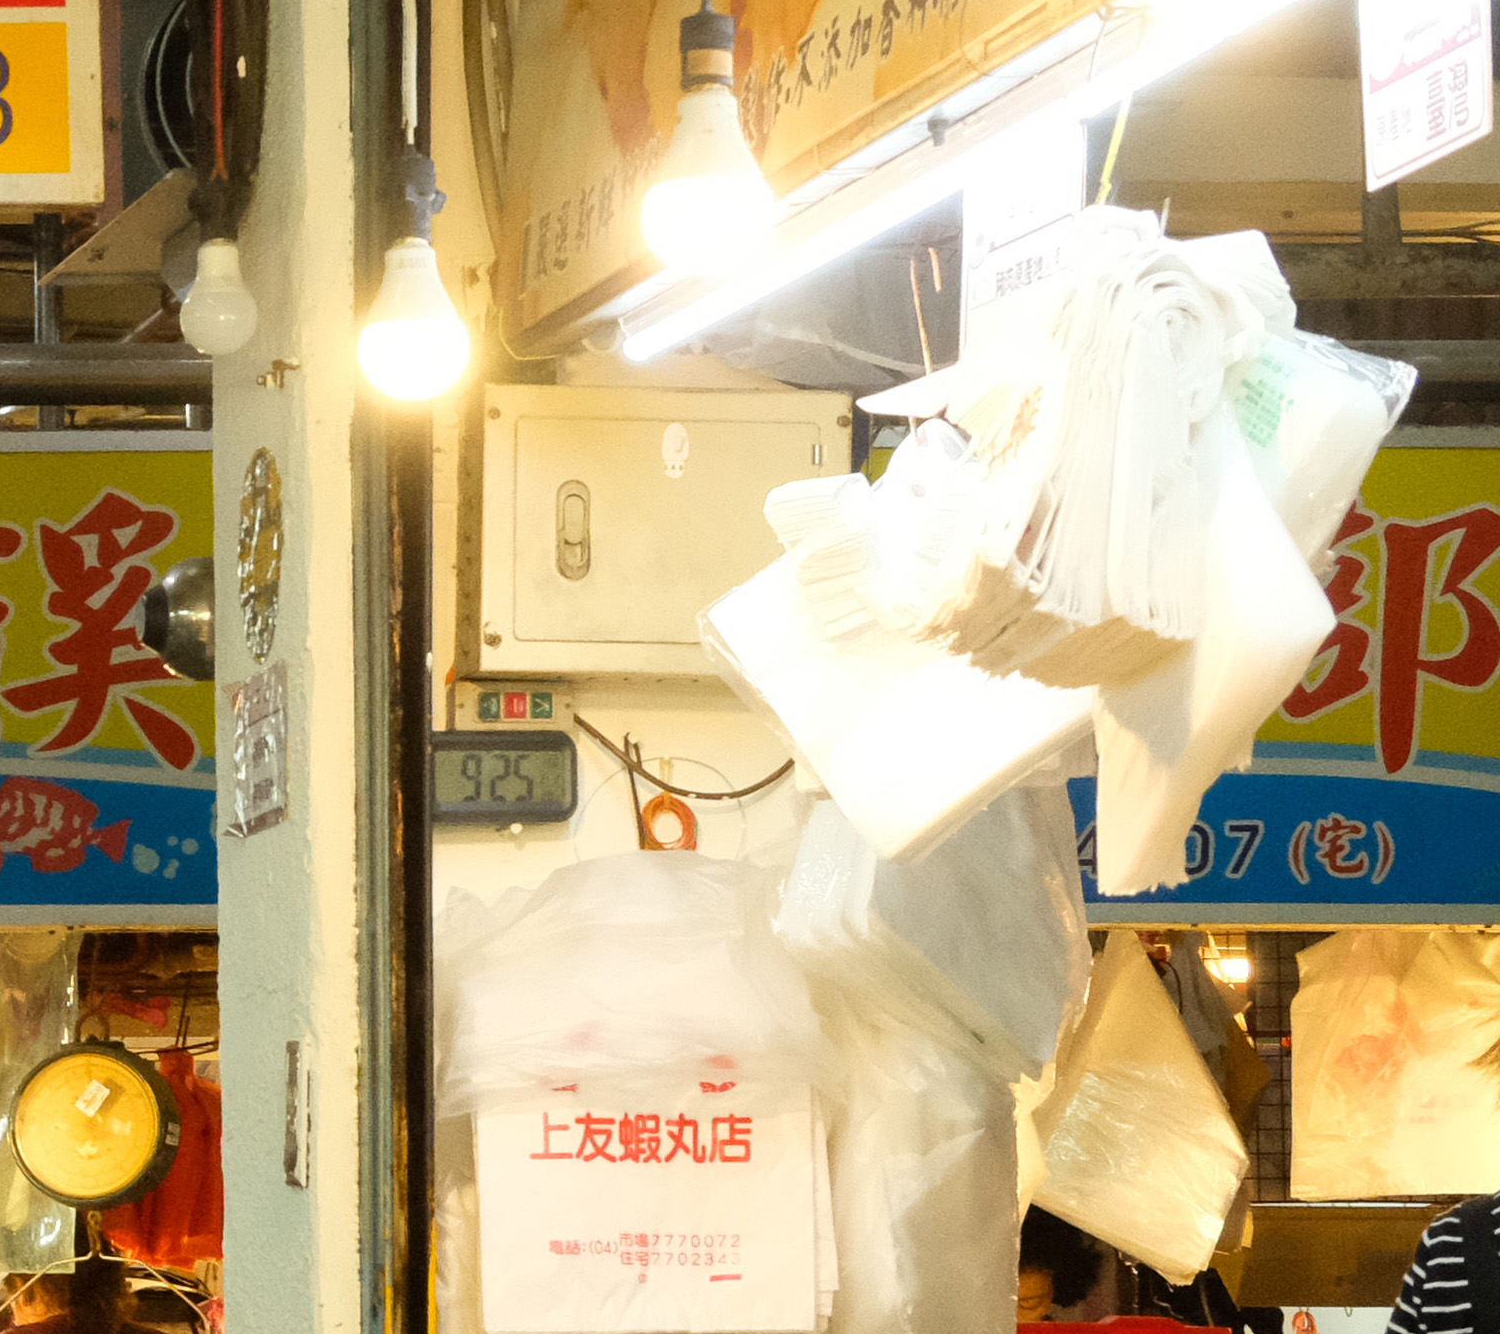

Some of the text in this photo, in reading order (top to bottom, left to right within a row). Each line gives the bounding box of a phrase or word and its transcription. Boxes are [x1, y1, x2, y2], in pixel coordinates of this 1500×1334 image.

[1288, 812, 1397, 886] (宅)
[529, 1112, 754, 1164] 上友蝦丸店
